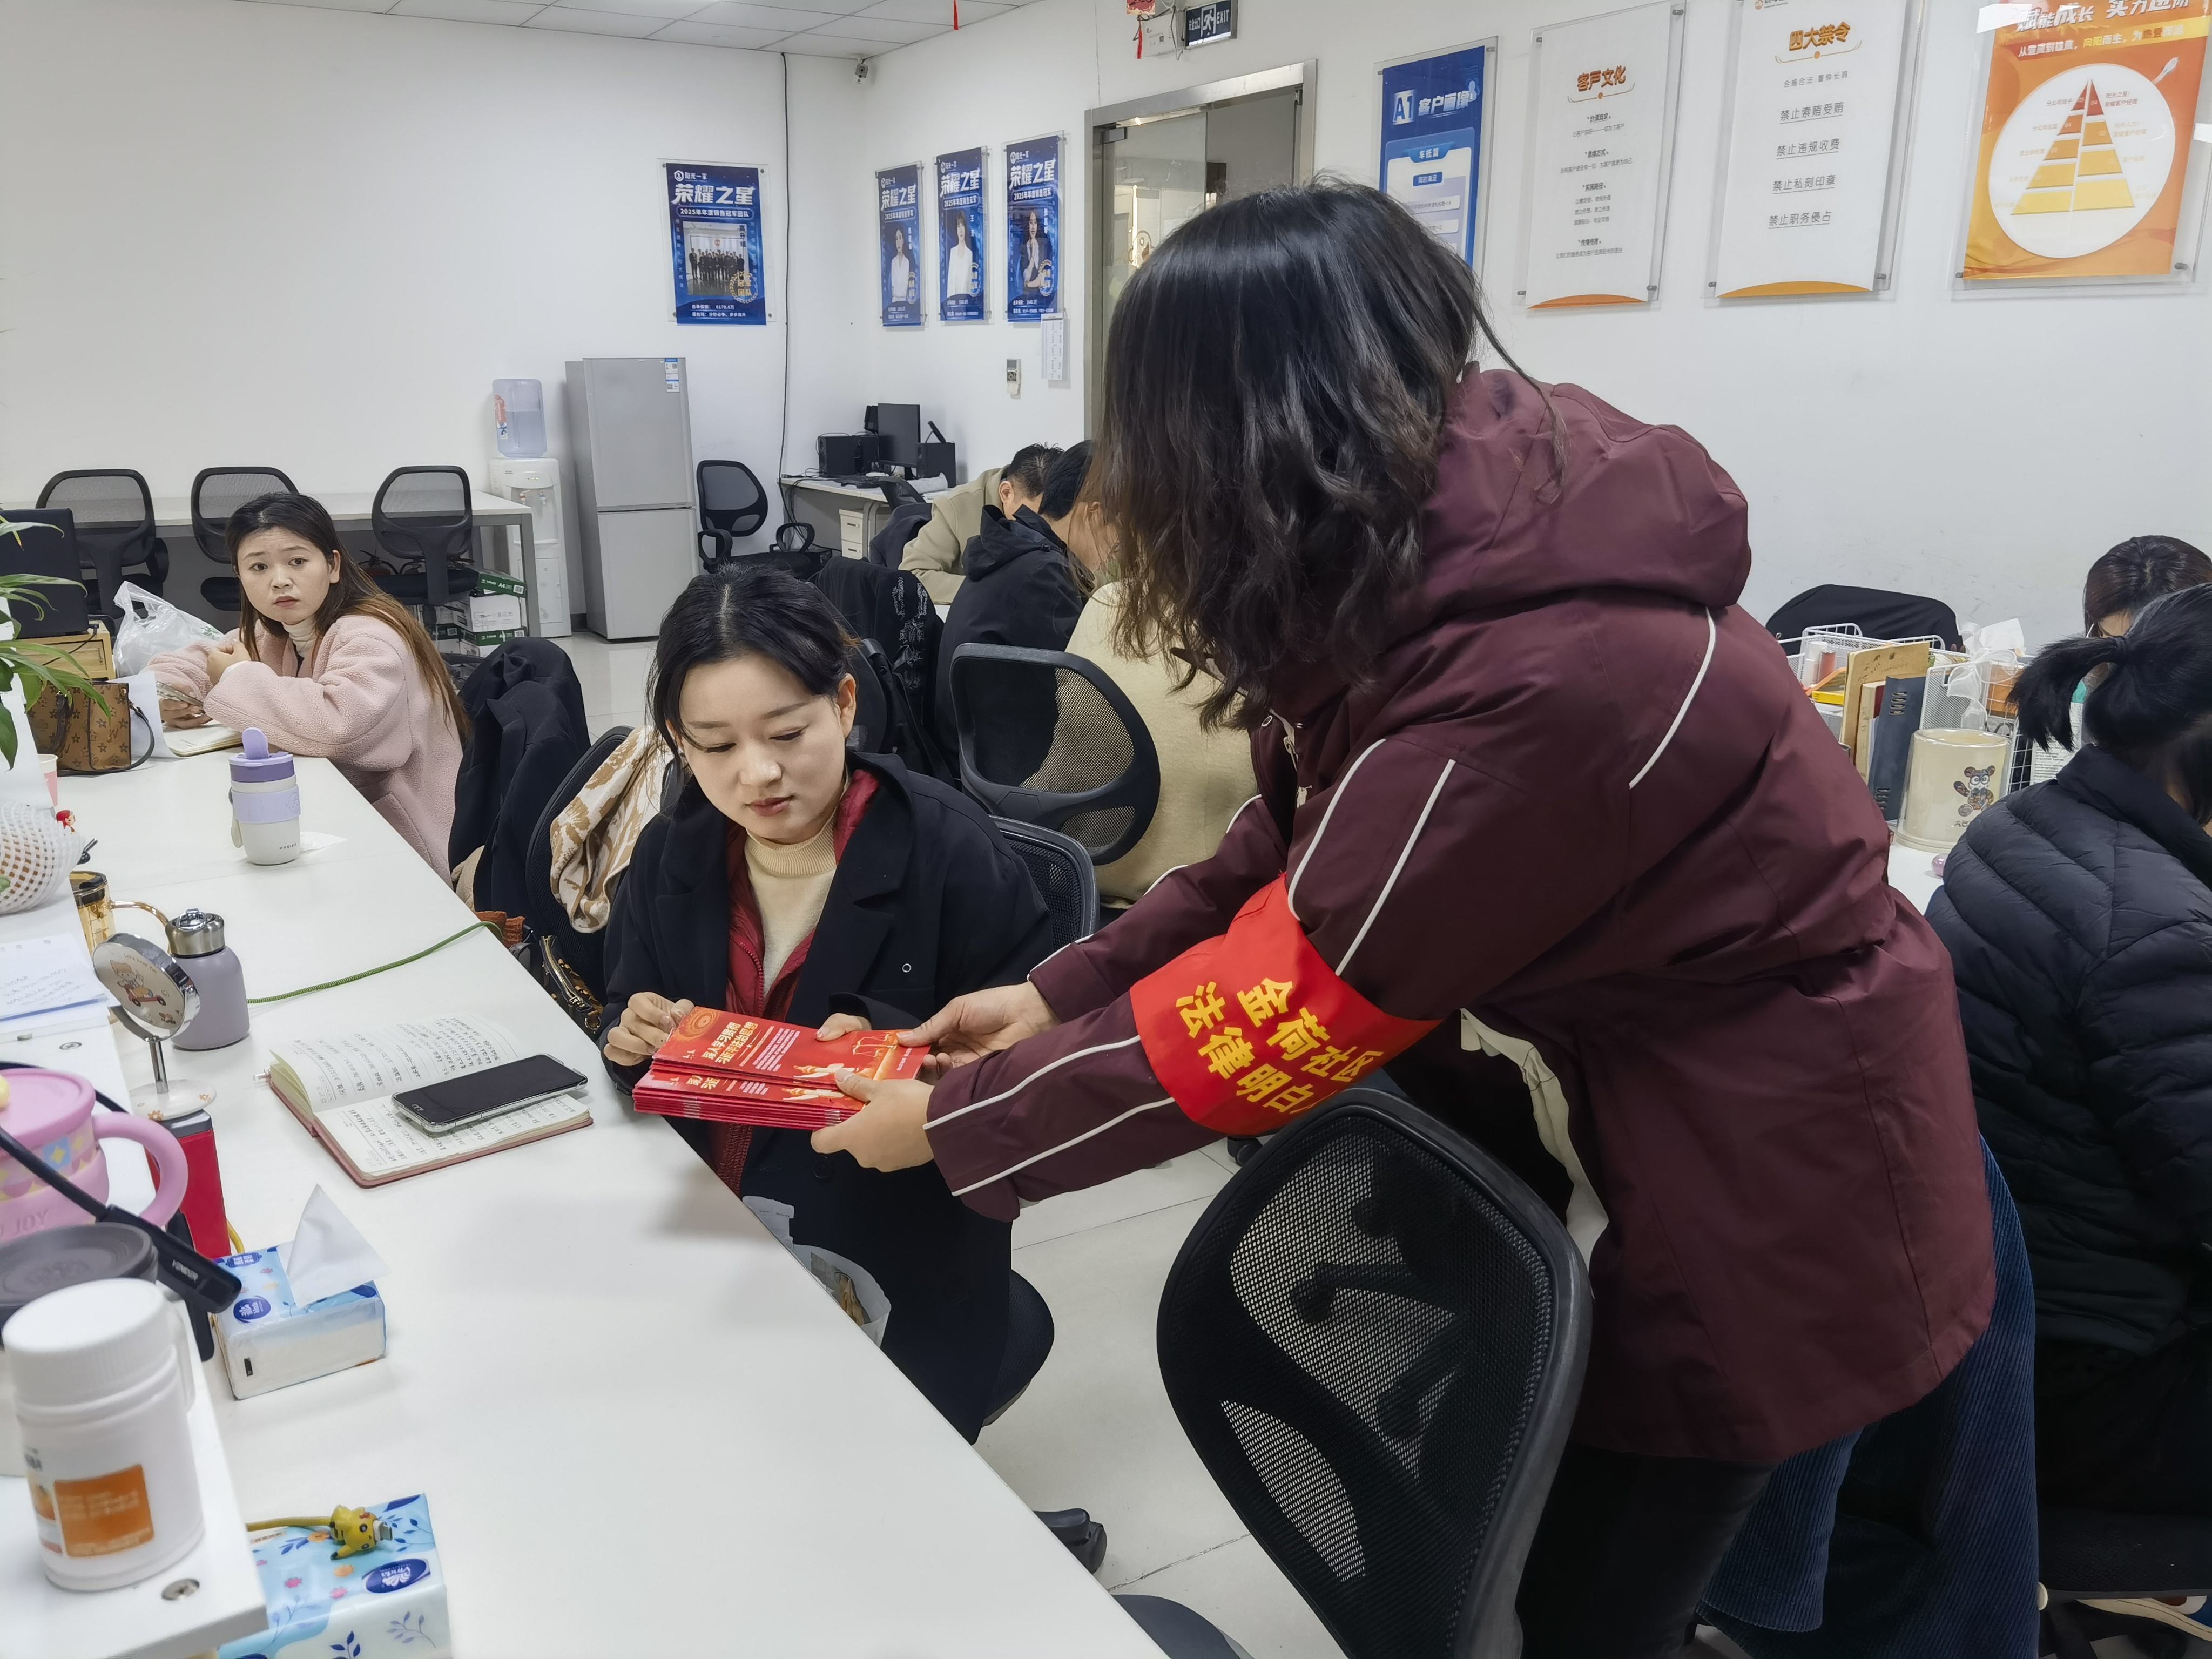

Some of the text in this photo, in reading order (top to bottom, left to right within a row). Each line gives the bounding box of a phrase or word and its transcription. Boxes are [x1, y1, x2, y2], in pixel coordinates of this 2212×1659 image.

[1217, 9, 1229, 24] EXIT
[1789, 21, 1851, 51] 四大禁令
[1577, 65, 1626, 92] 客户文化
[1784, 71, 1847, 88] 合规合法 警钟长鸣
[1394, 90, 1470, 122] A1 客户画像
[1780, 102, 1844, 122] 禁止索贿受贿
[1776, 139, 1840, 157] 禁止违规收费
[940, 168, 981, 198] 荣耀之星
[1009, 158, 1057, 190] 荣耀之星
[1772, 174, 1836, 192] 禁止私刻印章
[672, 184, 754, 205] 荣耀之星
[881, 184, 916, 211] 荣耀之星
[680, 208, 750, 218] 2025年年度销售冠军团队
[1768, 211, 1831, 226] 禁止职务侵占
[701, 1021, 741, 1060] 深入学习贯彻
[715, 1021, 759, 1064] 习近平法治思想
[1237, 978, 1384, 1082] 金荷社区
[1175, 981, 1340, 1115] 法律明白
[381, 1566, 412, 1577] Vinda
